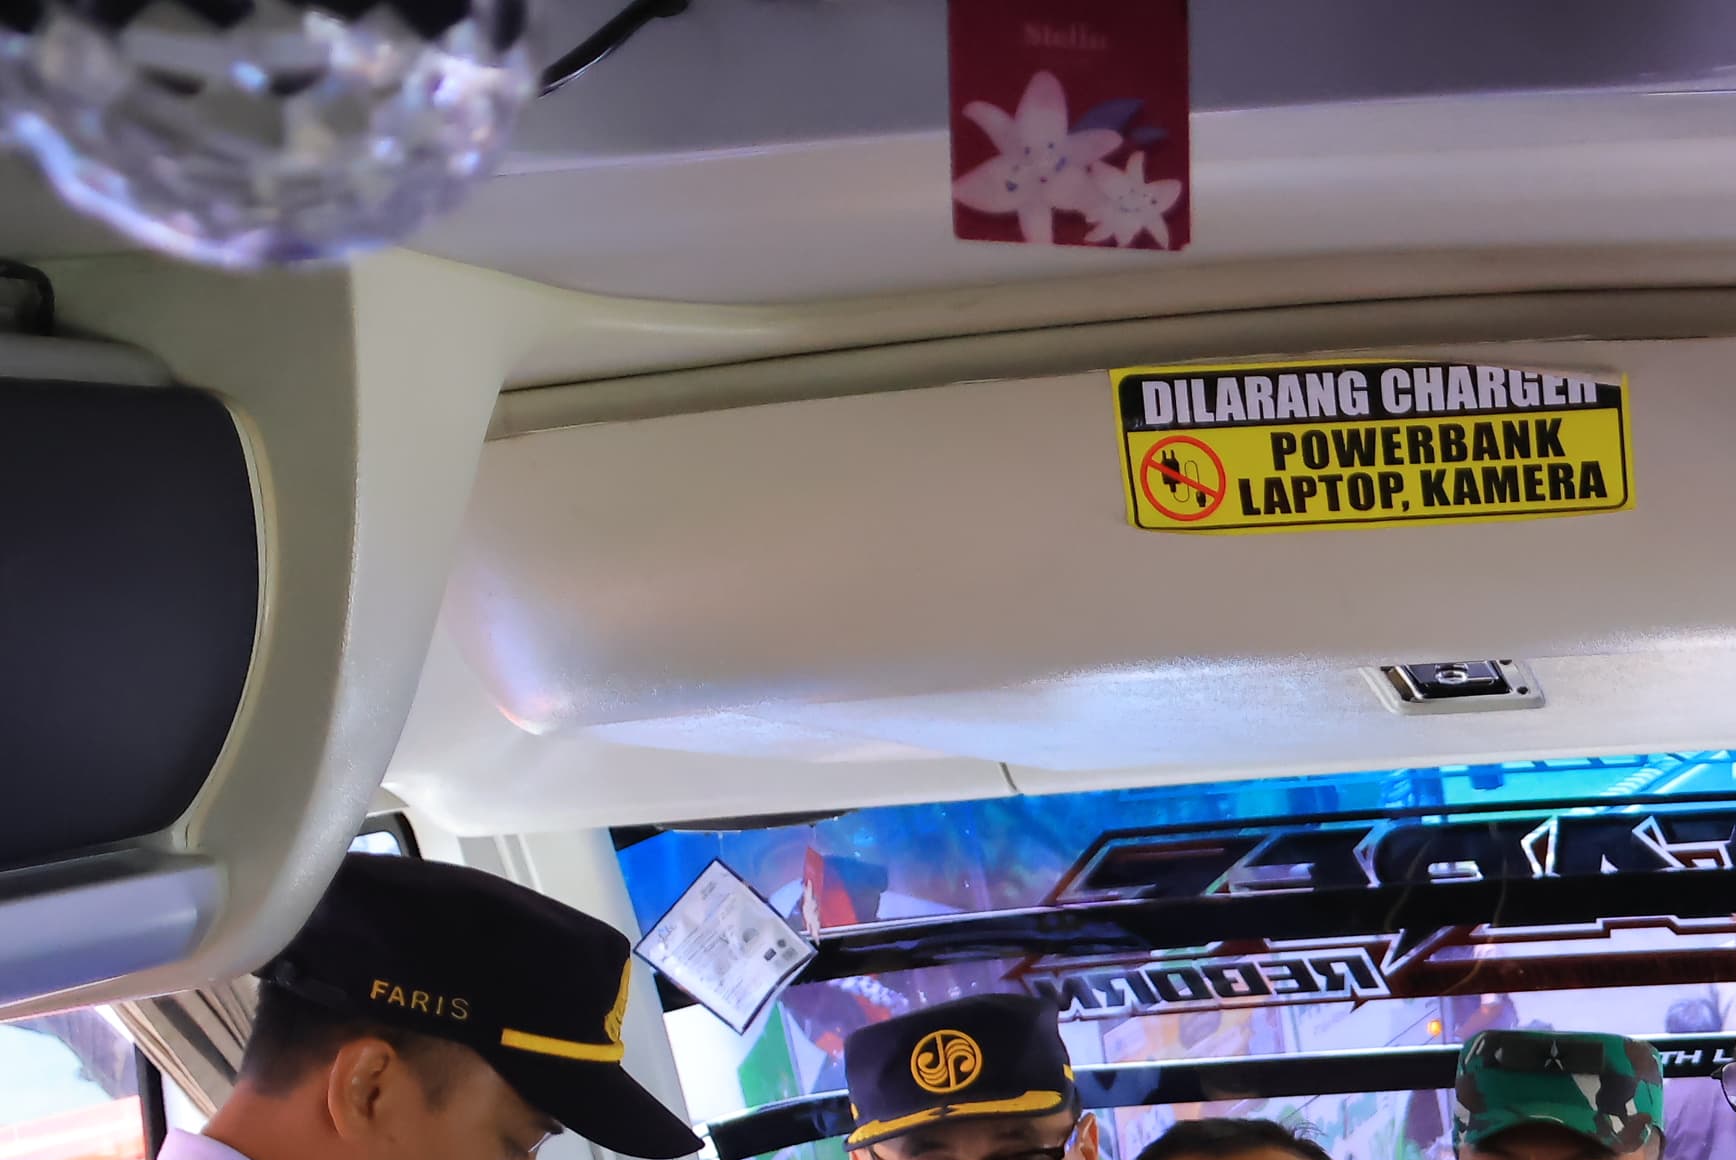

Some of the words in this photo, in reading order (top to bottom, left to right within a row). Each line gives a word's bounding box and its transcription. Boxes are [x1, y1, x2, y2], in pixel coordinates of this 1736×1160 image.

[1141, 370, 1371, 425] DILARANG
[1271, 417, 1566, 472] POWERBANK
[1239, 469, 1410, 517] LAPTOP,
[1420, 460, 1607, 508] KAMERA
[370, 979, 469, 1020] FARIS
